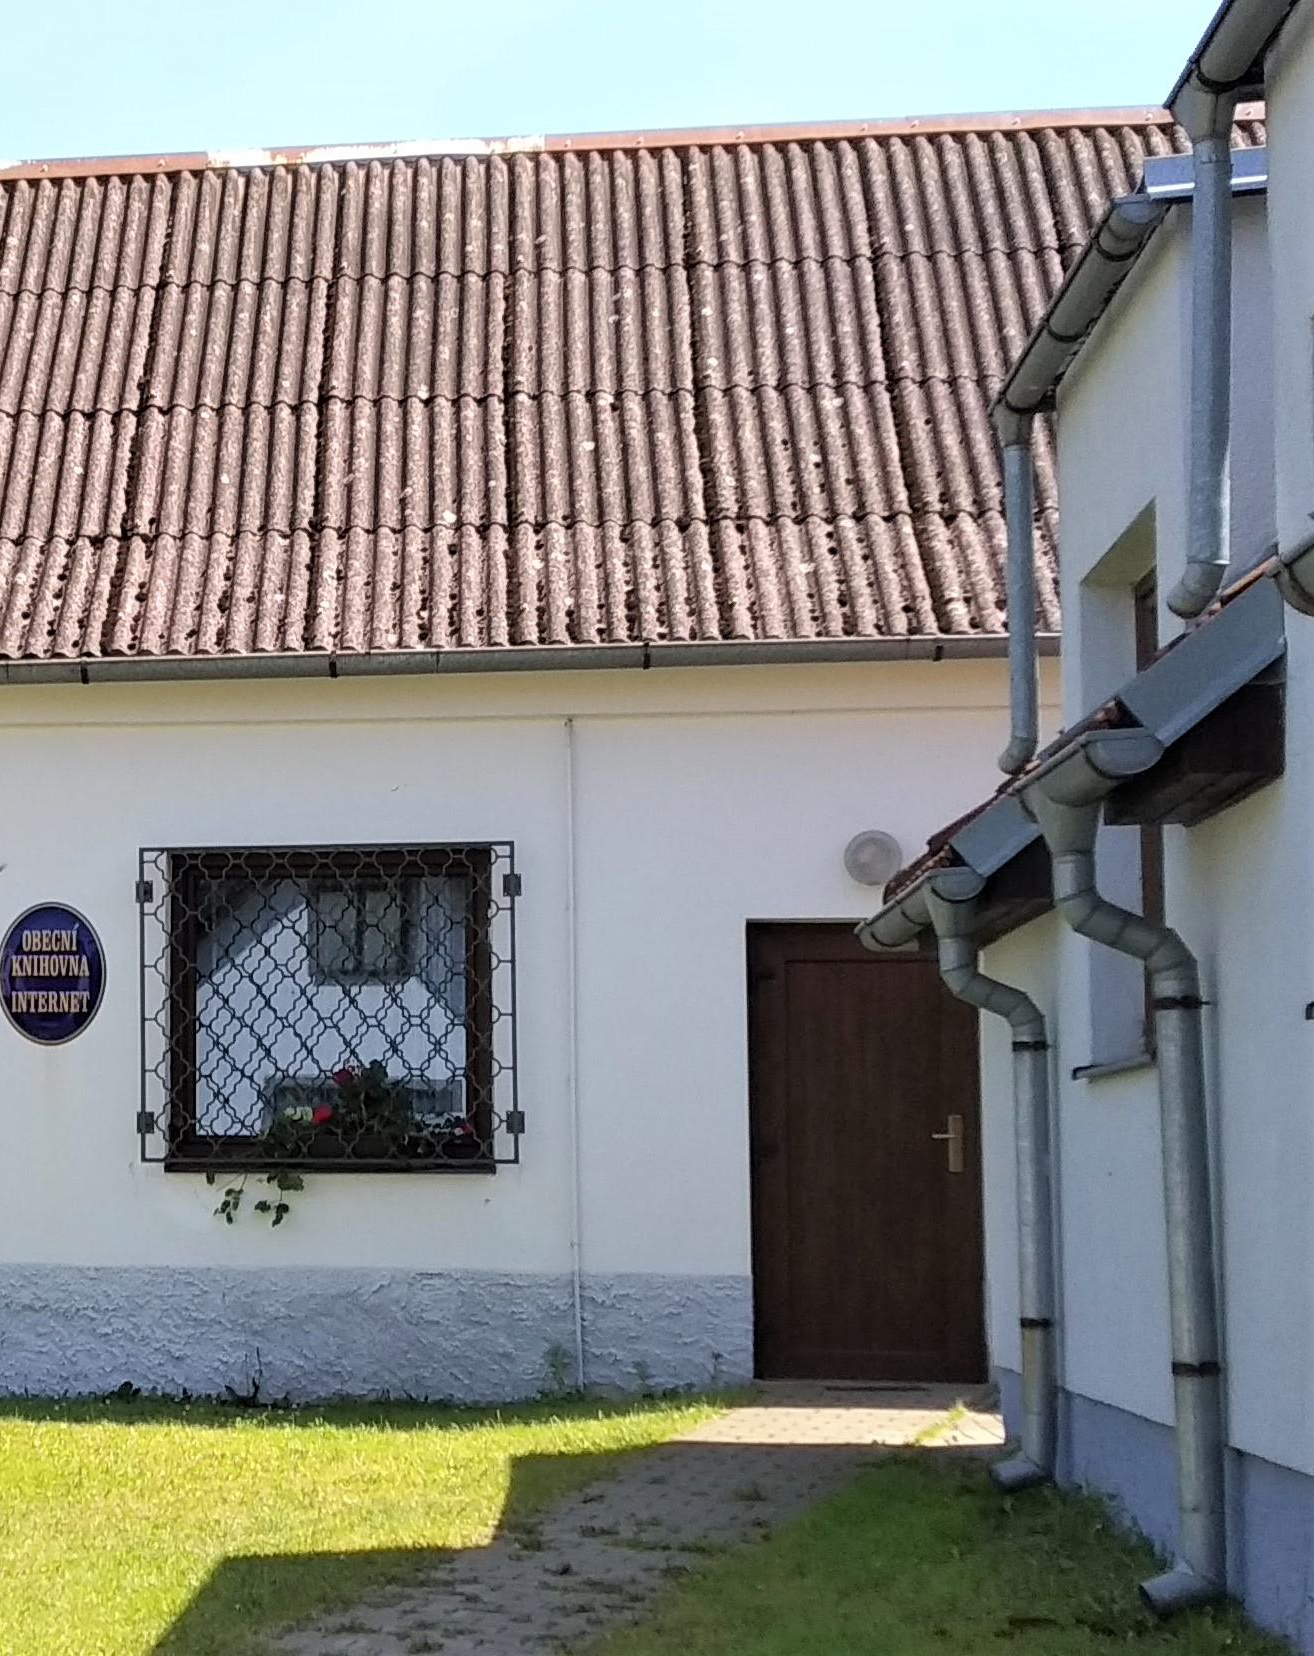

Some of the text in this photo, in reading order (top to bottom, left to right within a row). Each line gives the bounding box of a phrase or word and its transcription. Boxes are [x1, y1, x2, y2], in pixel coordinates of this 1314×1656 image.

[22, 922, 79, 952] OBECNÍ
[11, 954, 90, 977] KNIHOVNA
[11, 990, 90, 1013] INTERNET
